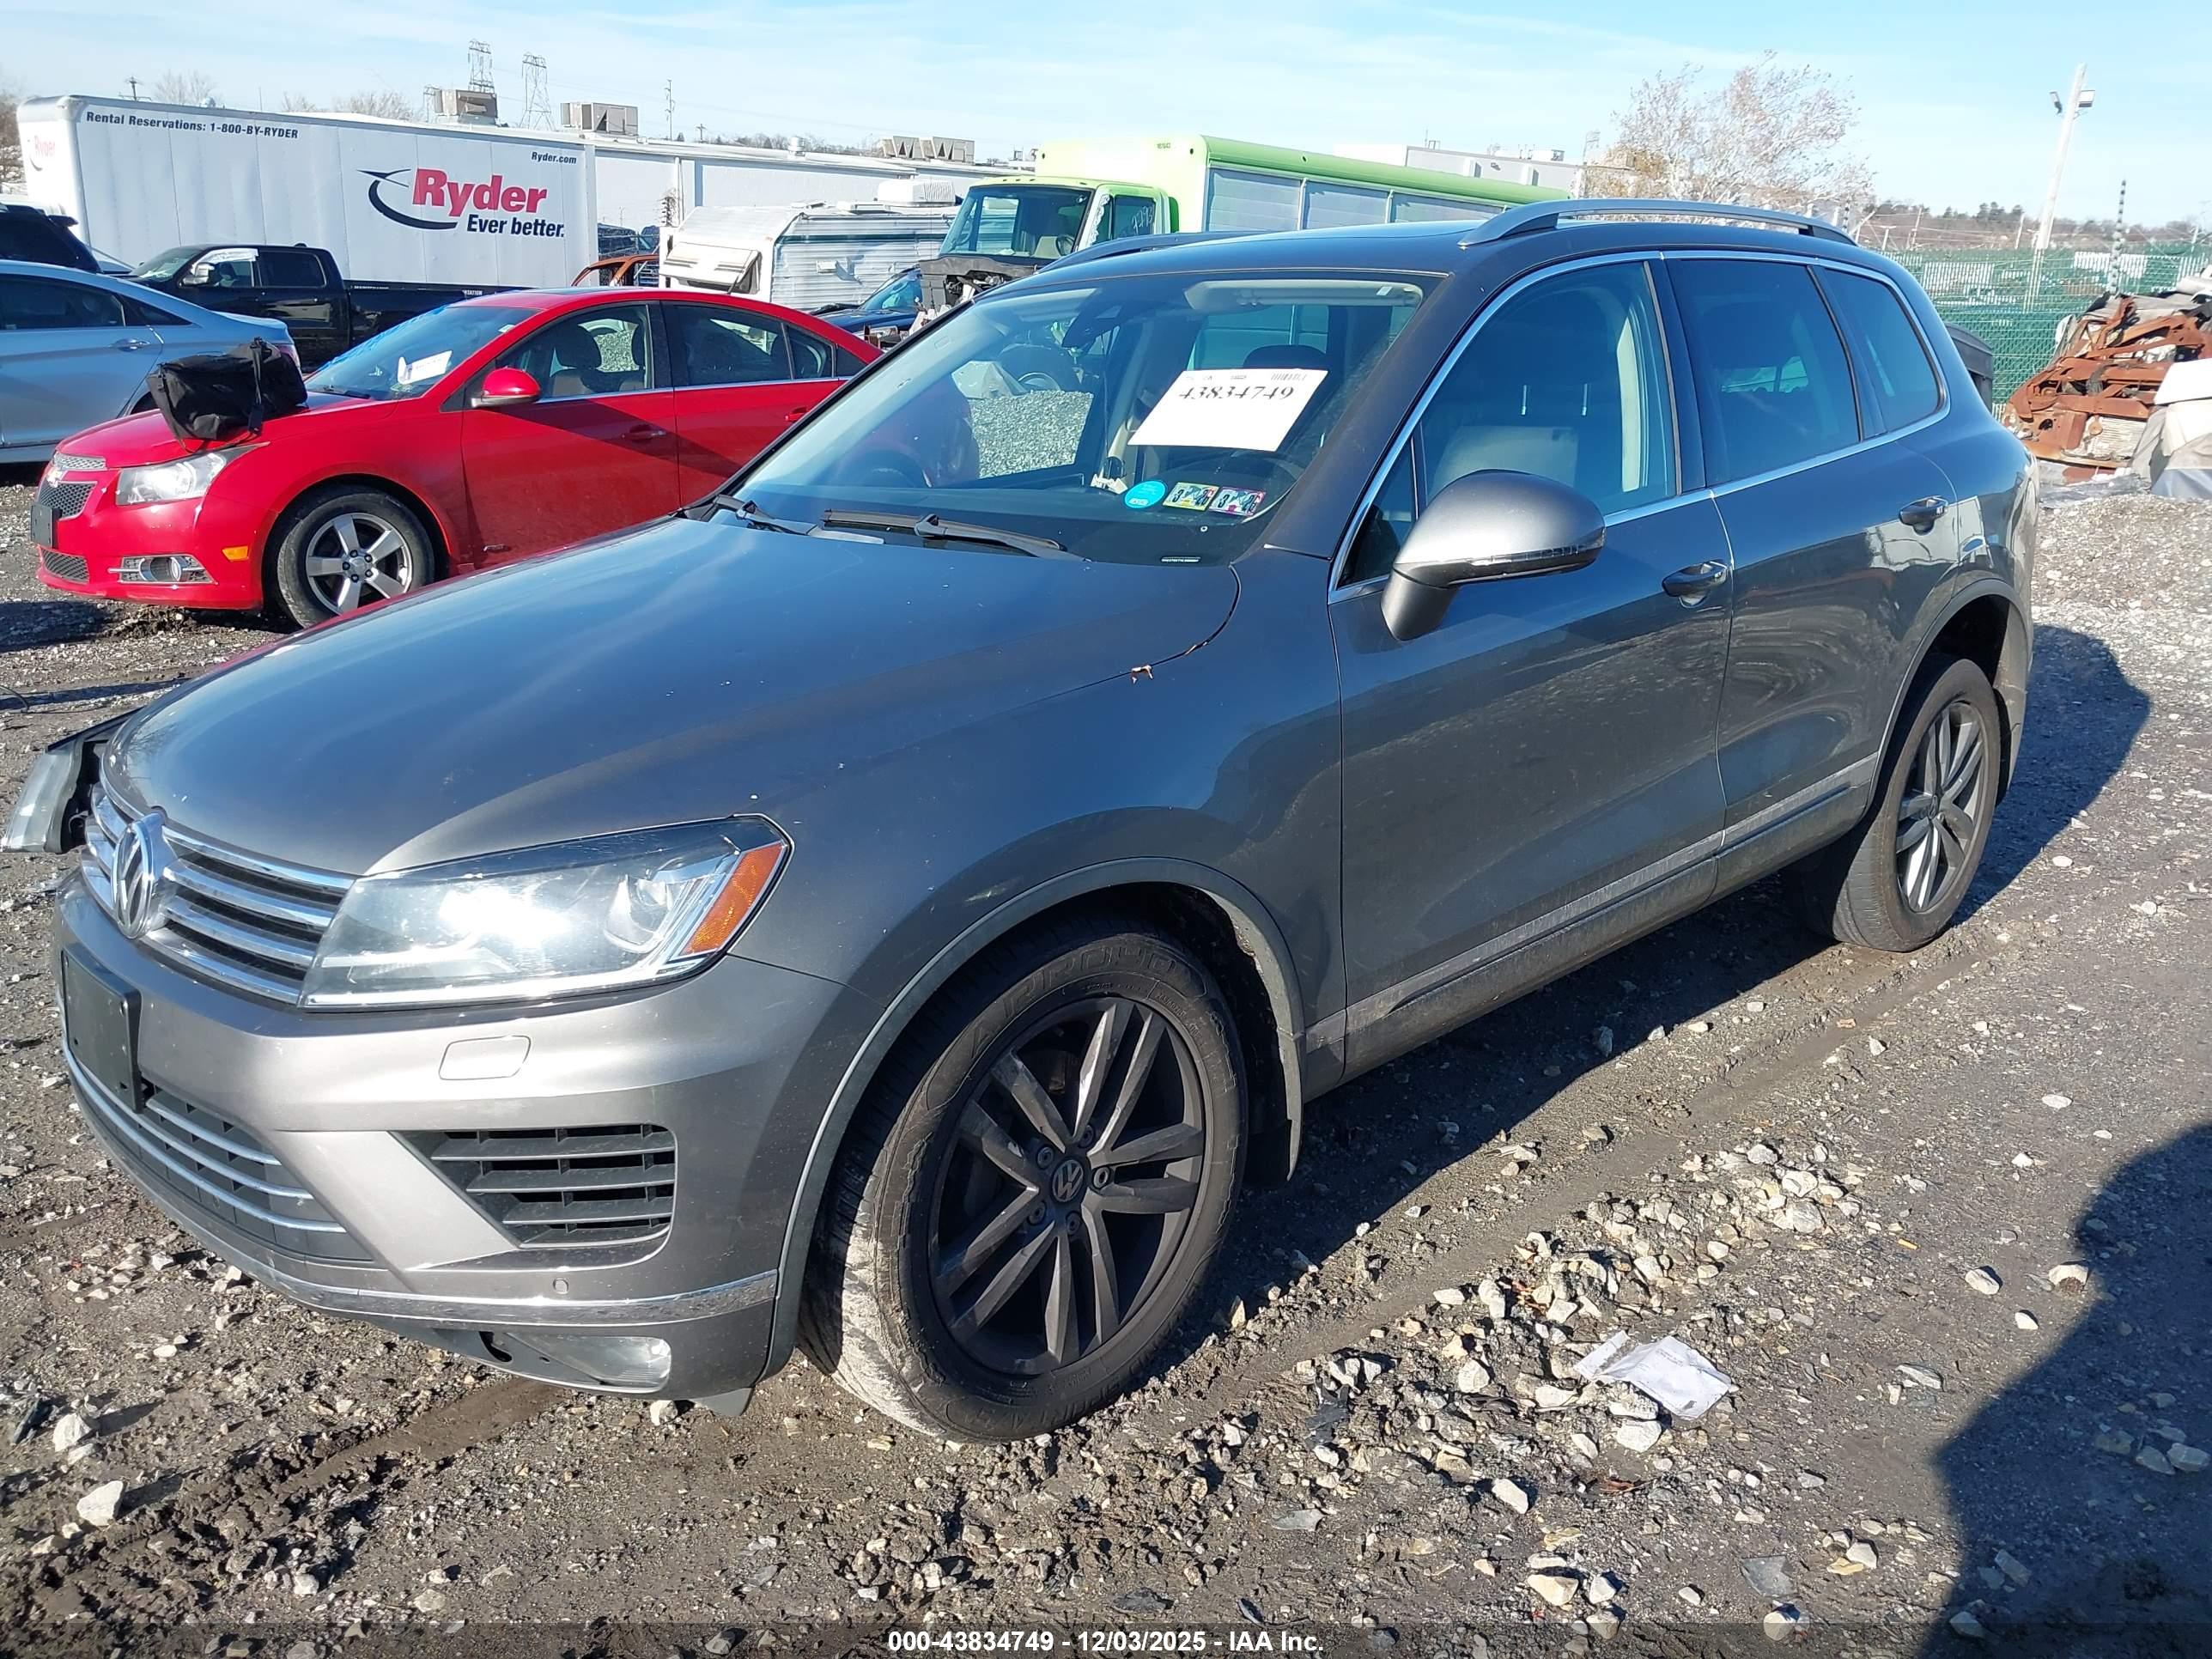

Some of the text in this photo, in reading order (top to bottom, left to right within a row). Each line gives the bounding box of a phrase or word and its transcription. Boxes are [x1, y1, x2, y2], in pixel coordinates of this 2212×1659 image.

[86, 112, 299, 139] Rental Reservations: 1-800-BY-RYDER
[531, 151, 577, 164] Ryder.com
[412, 168, 548, 217] Ryder
[466, 214, 565, 238] Ever better.
[1179, 386, 1295, 400] 43834749
[1172, 489, 1184, 503] 3
[1218, 494, 1230, 508] 3
